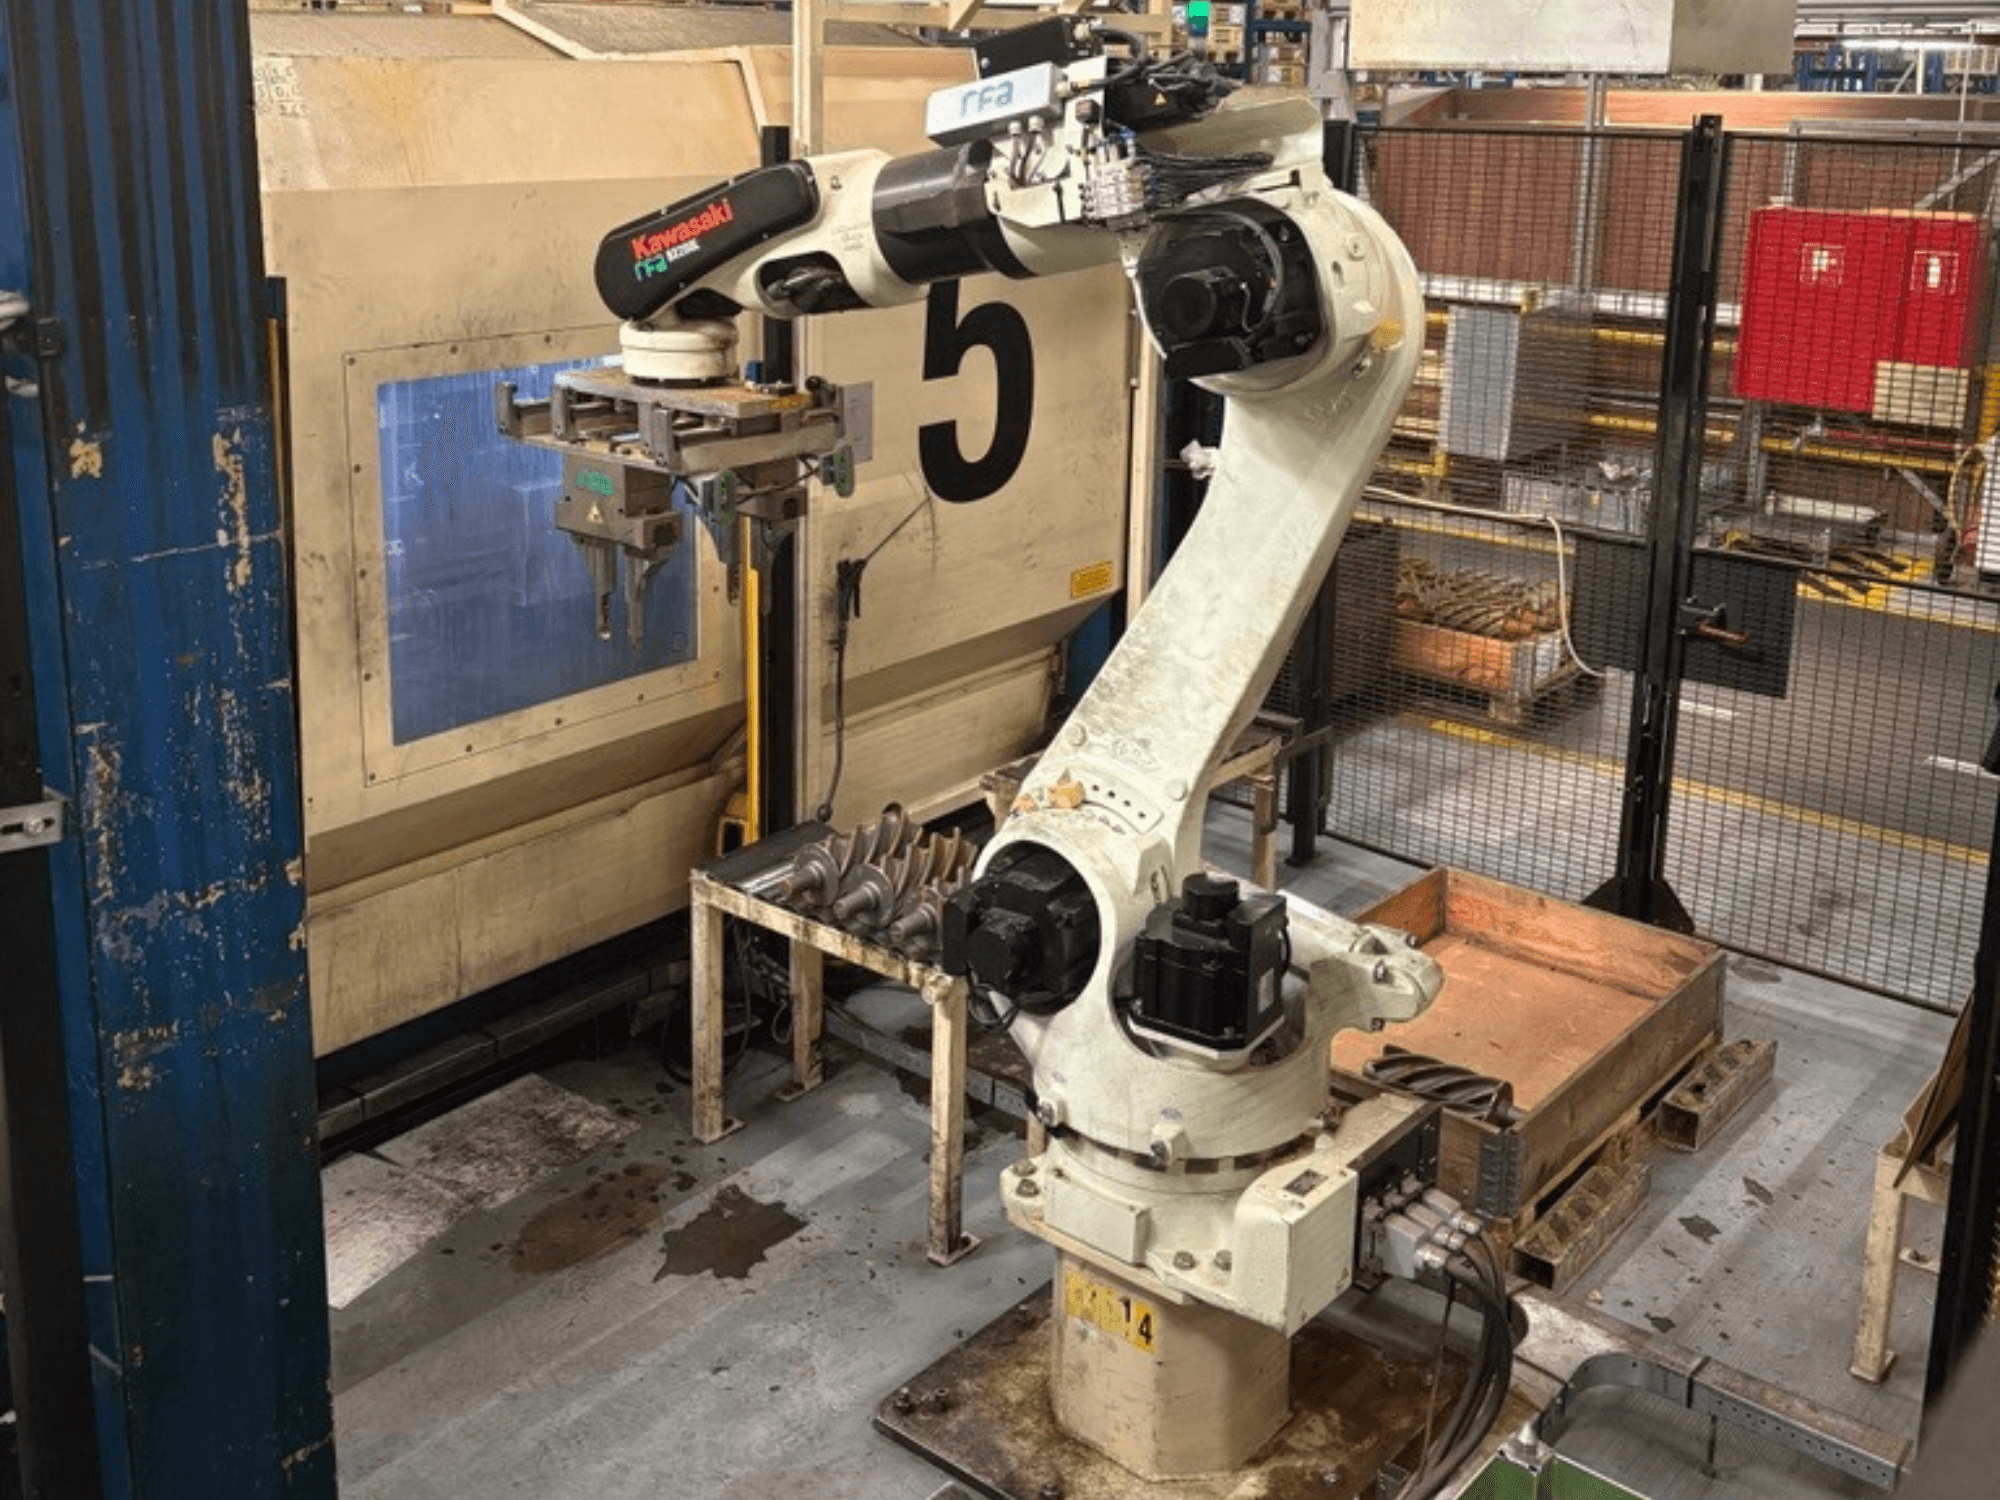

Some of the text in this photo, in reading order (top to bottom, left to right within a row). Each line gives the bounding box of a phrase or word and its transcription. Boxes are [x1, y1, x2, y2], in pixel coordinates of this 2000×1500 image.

[960, 80, 1014, 117] rfa
[631, 198, 733, 260] Kawasaki
[919, 279, 1034, 503] 5
